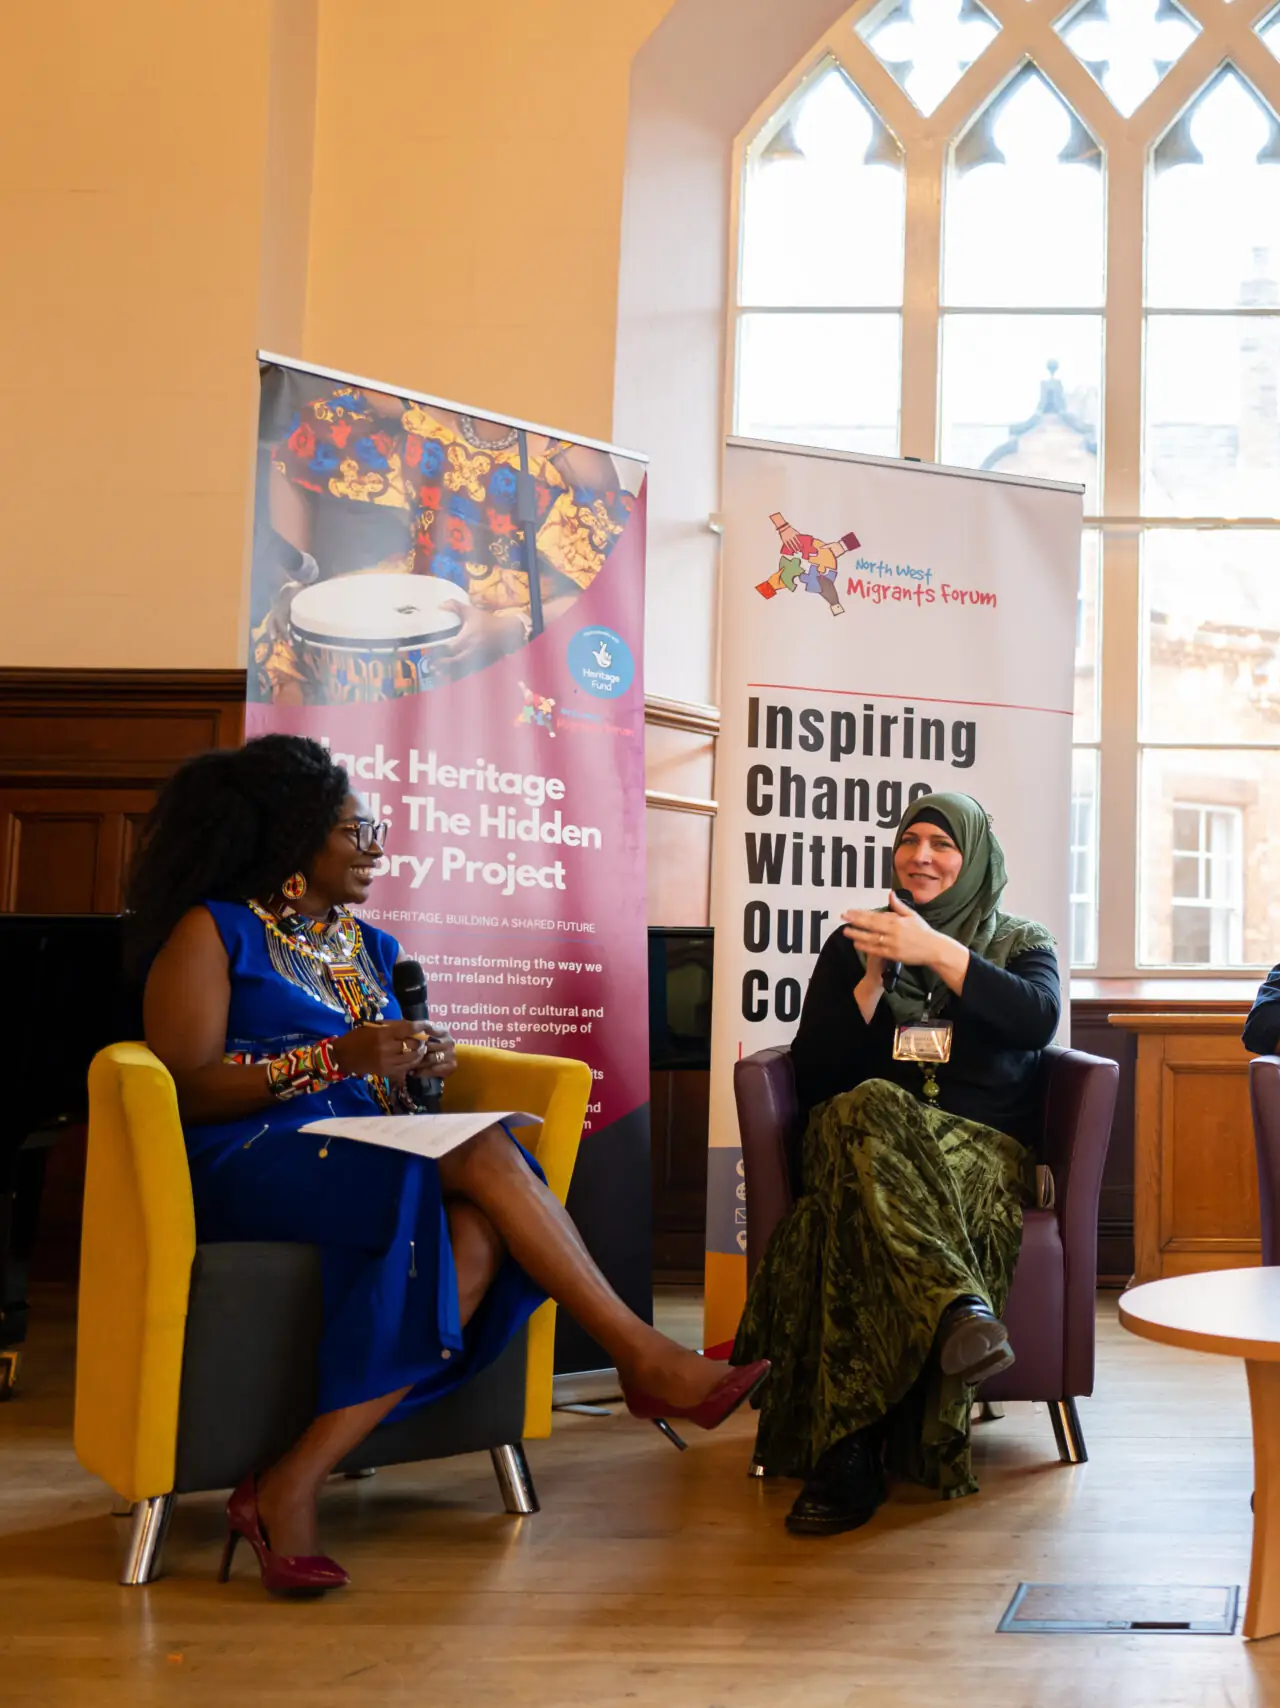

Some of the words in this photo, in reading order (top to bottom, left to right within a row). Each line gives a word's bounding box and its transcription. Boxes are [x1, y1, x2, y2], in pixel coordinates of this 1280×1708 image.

[855, 557, 892, 578] North
[896, 565, 932, 585] West
[846, 577, 936, 607] Migrants
[583, 668, 620, 684] Heritage
[592, 679, 612, 691] Fund
[747, 696, 976, 768] Inspiring
[320, 736, 400, 782] ack
[409, 749, 565, 806] Heritage
[402, 795, 471, 836] The
[479, 803, 602, 849] Hidden
[442, 846, 566, 895] Project
[744, 832, 893, 889] Withi
[446, 914, 498, 927] BUILDING
[500, 917, 509, 927] A
[511, 918, 555, 930] SHARED
[557, 920, 596, 933] FUTURE
[743, 900, 829, 954] Our
[443, 954, 531, 971] transforming
[534, 958, 555, 970] the
[558, 961, 582, 973] way
[585, 963, 603, 972] we
[456, 971, 503, 984] Ireland
[507, 972, 553, 988] history
[451, 1002, 509, 1015] tradition
[512, 1004, 527, 1015] of
[529, 1005, 578, 1017] cultural
[581, 1006, 604, 1018] and
[482, 1020, 503, 1032] the
[507, 1022, 577, 1035] stereotype
[580, 1022, 592, 1034] of
